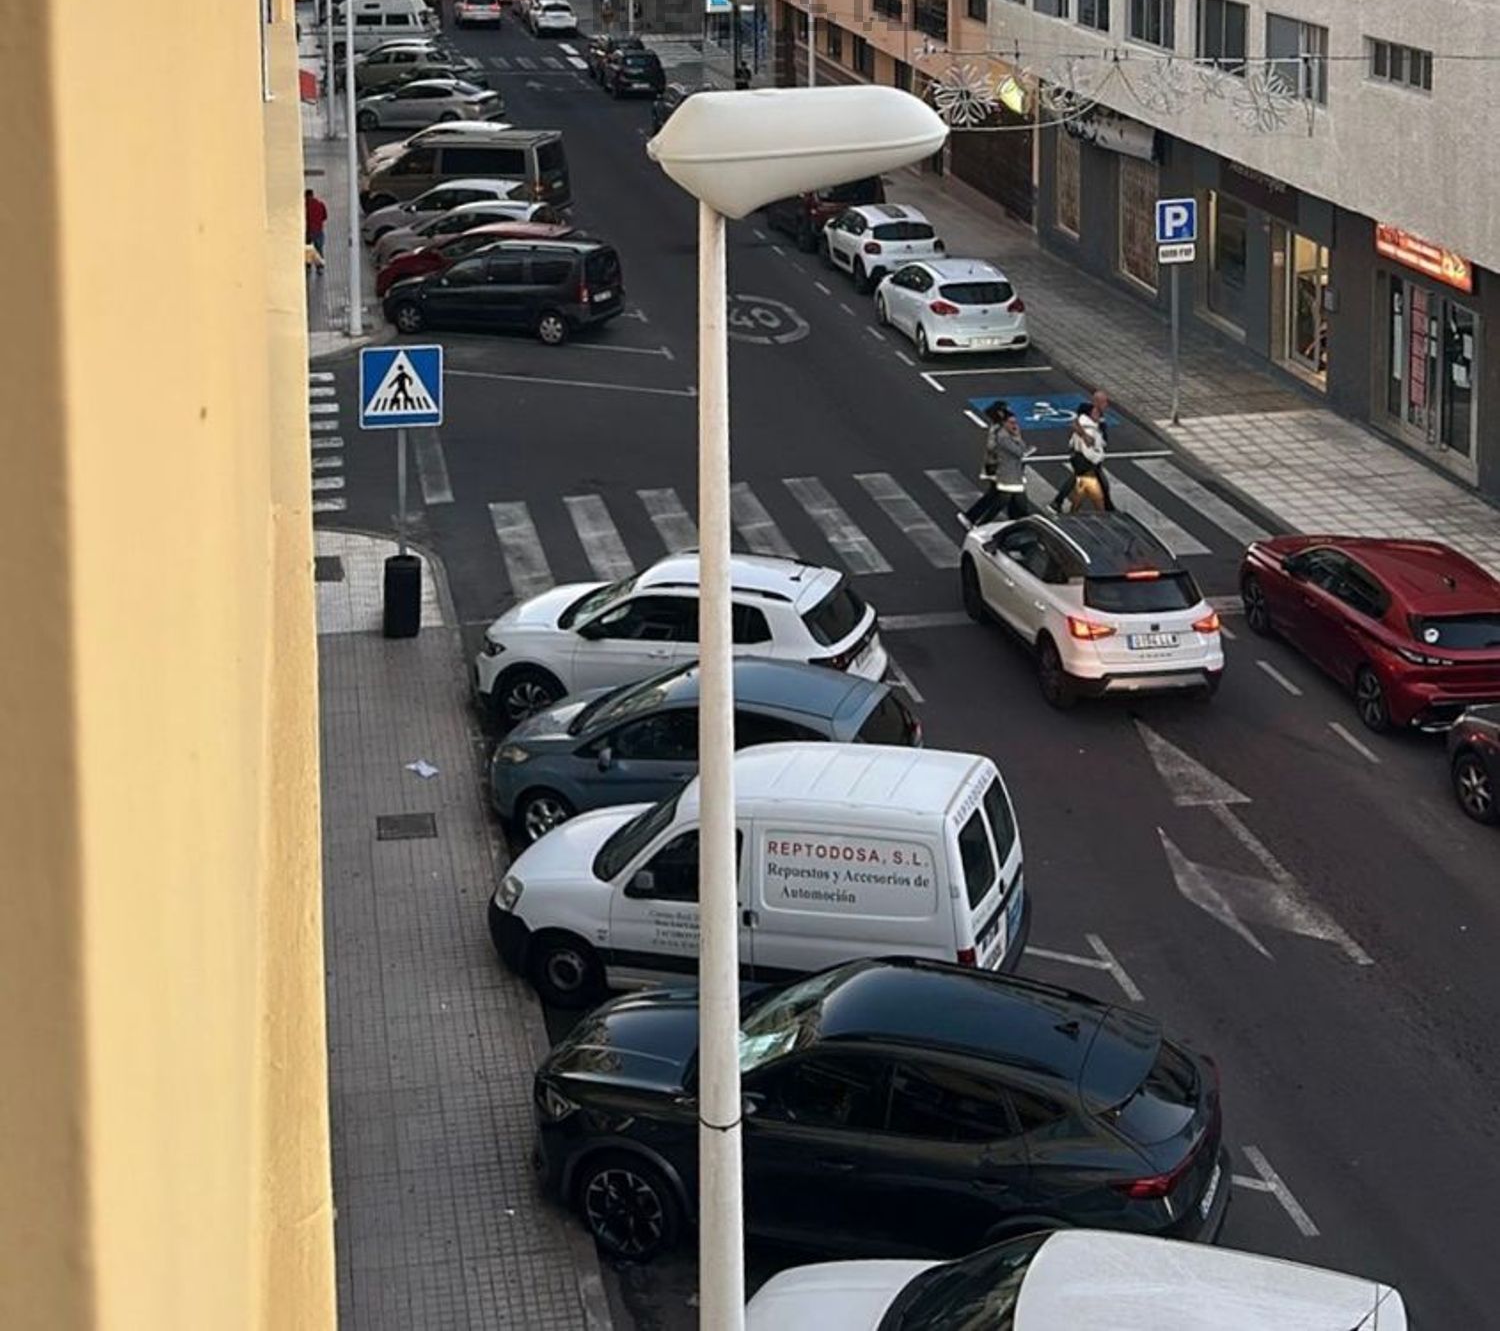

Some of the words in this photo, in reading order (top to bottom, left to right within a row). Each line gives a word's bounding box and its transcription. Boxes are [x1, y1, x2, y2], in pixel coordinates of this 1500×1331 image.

[1165, 206, 1189, 237] P
[767, 862, 830, 880] Repuestos
[833, 871, 840, 884] y
[843, 870, 911, 887] Accesorios
[914, 875, 930, 888] de
[781, 885, 856, 904] Automoción
